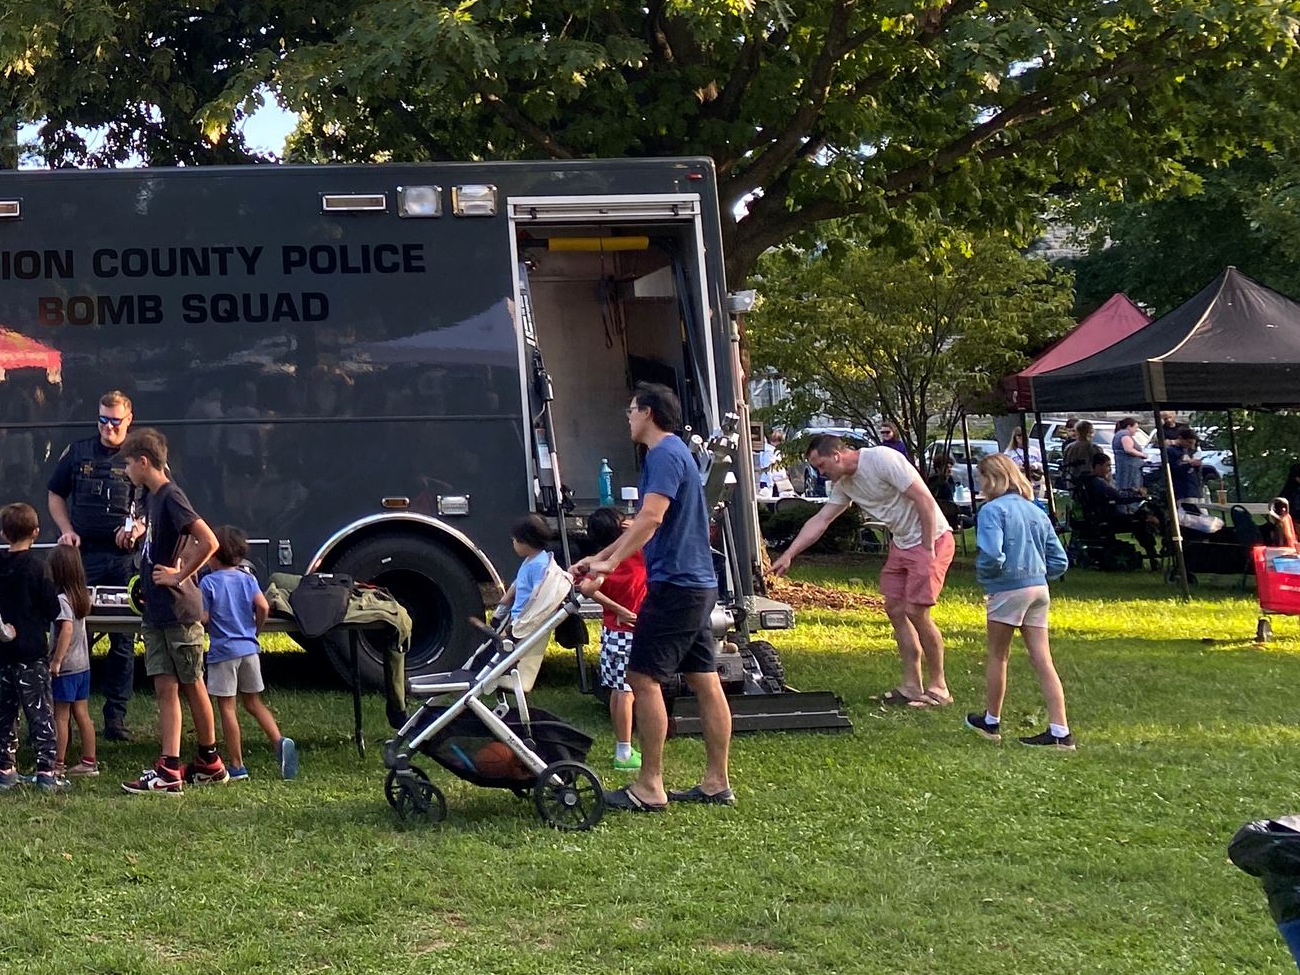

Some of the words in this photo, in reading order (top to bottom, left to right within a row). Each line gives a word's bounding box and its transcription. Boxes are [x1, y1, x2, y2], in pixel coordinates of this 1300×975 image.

[92, 246, 264, 277] COUNTY
[282, 243, 426, 275] POLICE
[38, 294, 164, 326] BOMB
[181, 292, 330, 324] SQUAD
